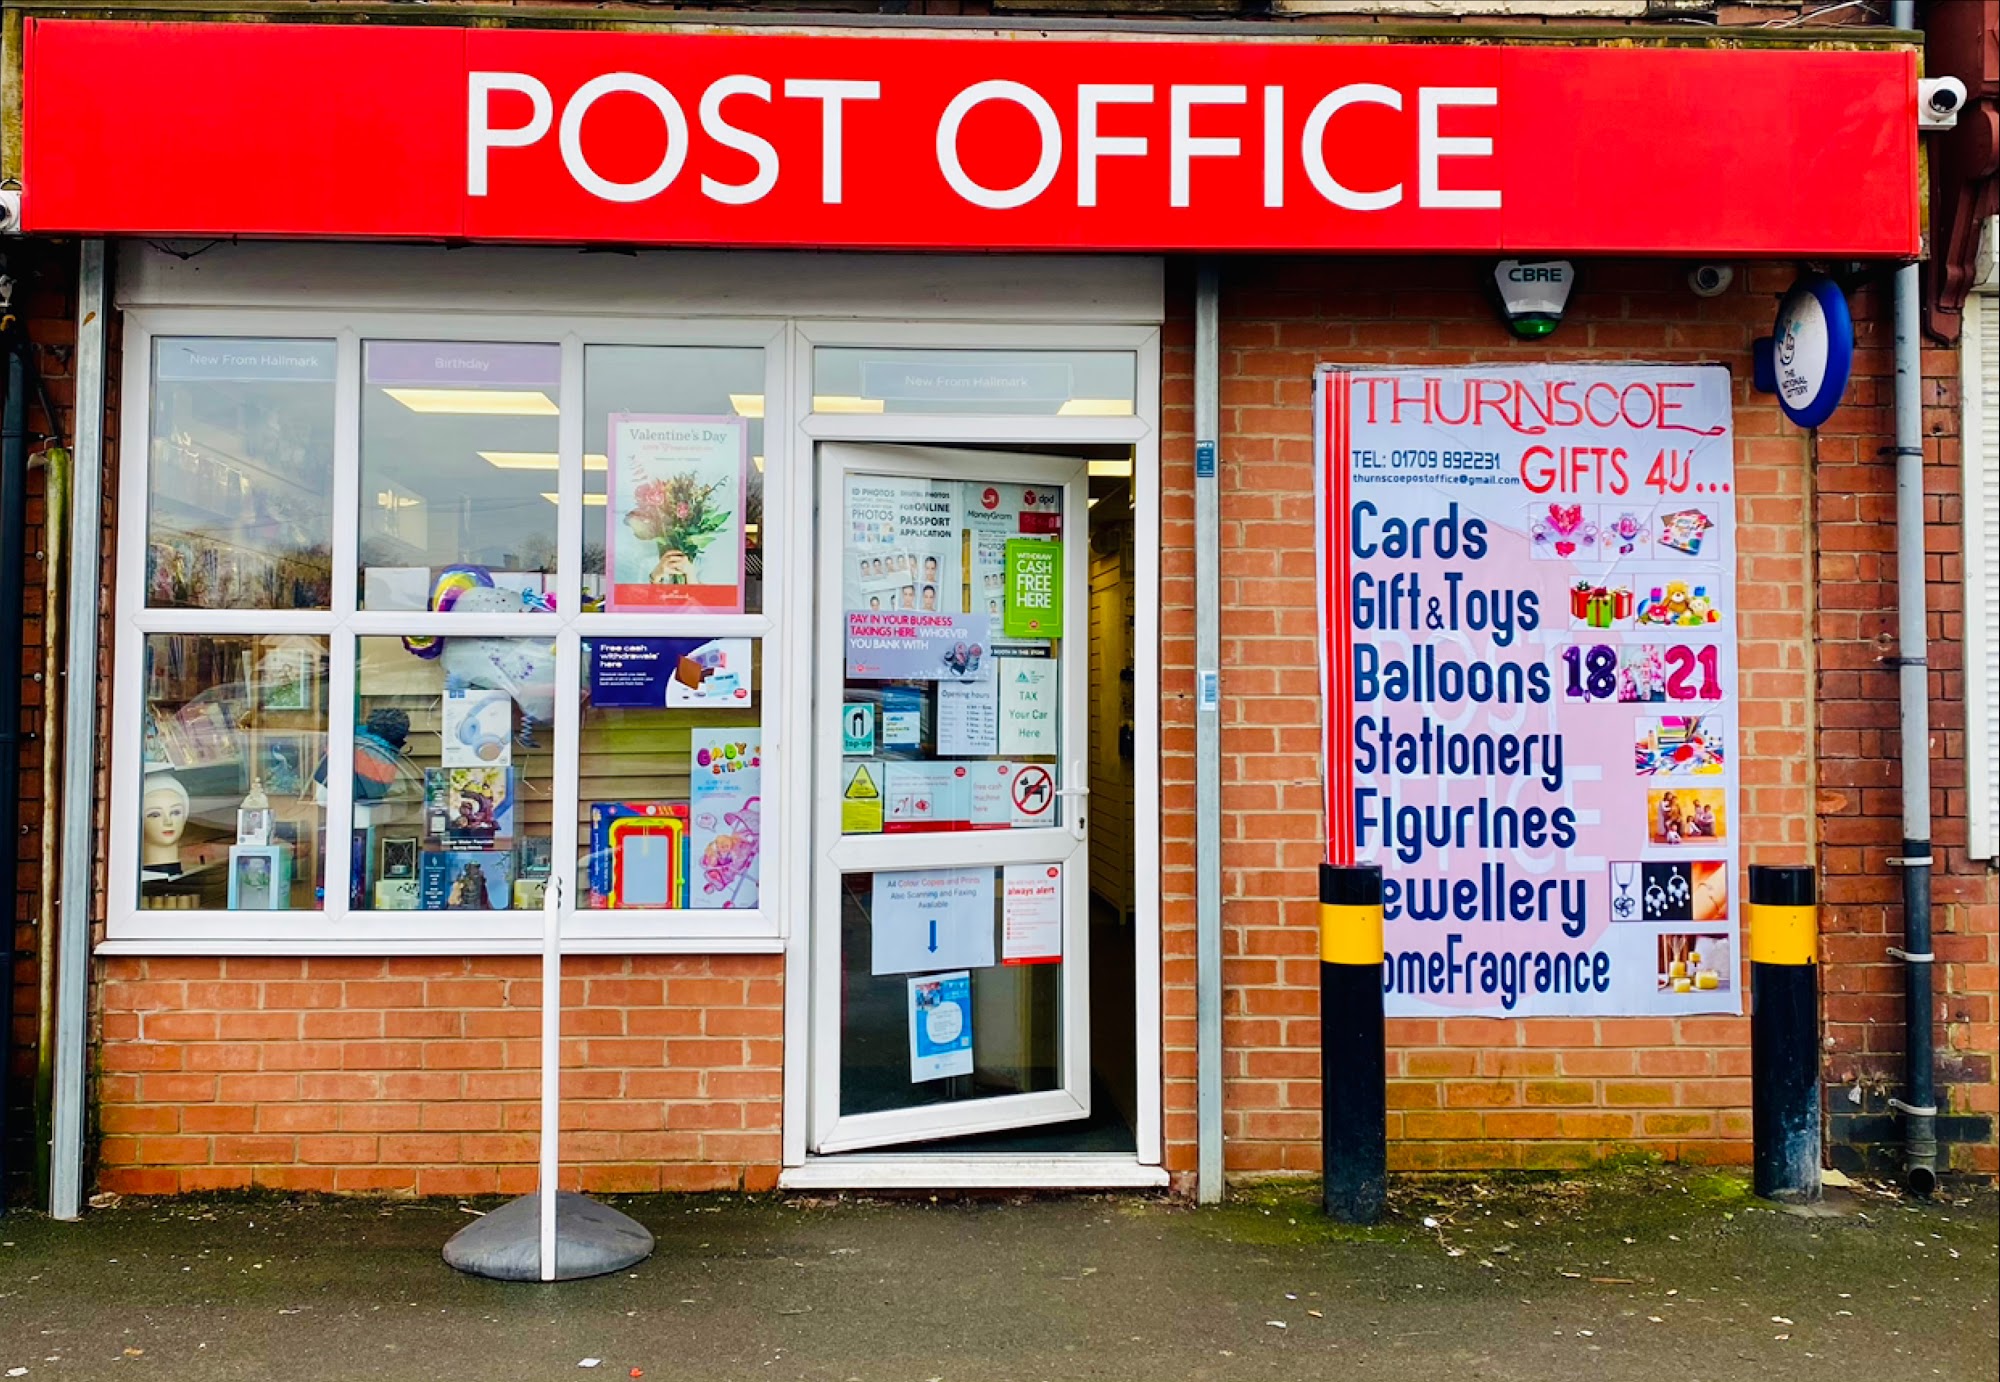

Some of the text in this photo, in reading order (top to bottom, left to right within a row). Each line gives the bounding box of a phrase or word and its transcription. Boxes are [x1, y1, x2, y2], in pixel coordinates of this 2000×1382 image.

[466, 71, 1502, 211] POST OFFICE
[1508, 267, 1562, 282] CBRE
[190, 353, 319, 369] New From Hallmark
[434, 357, 490, 371] Birthday
[905, 375, 1029, 388] New From Hallmark
[1351, 377, 1727, 437] THURNSCOE
[629, 427, 728, 444] Valentine's Day
[1352, 450, 1501, 470] TEL: 01709 892231
[1519, 444, 1629, 496] GIFTS
[1353, 473, 1520, 486] thurnscoepostoffice@gmail.com
[862, 488, 895, 497] PHOTOS
[1039, 494, 1055, 505] dpd
[914, 503, 950, 512] ONLINE
[852, 509, 895, 521] PHOTOS
[900, 515, 951, 526] PASSPORT
[968, 510, 1013, 521] MoneyGram
[900, 528, 951, 538] APPLICATION
[1352, 501, 1488, 560] Cards
[1016, 552, 1053, 561] WITHDRAW
[1016, 559, 1053, 574] CASH
[1016, 573, 1053, 592] FREE
[1016, 591, 1053, 609] HERE
[851, 614, 953, 627] PAY IN YOUR BUSINESS
[851, 625, 892, 636] TAKINGS
[919, 628, 968, 638] WHOEVER
[600, 644, 648, 652] Free cash
[851, 638, 929, 650] YOU BANK WITH
[600, 660, 623, 668] here
[1353, 643, 1551, 704] Balloons
[941, 689, 990, 700] Opening hours
[1019, 691, 1038, 701] TAX
[1009, 709, 1048, 720] Your Car
[1018, 728, 1041, 738] Here
[845, 740, 872, 749] top-up
[1354, 715, 1563, 792] Stationery
[712, 756, 760, 775] STROLLE
[1354, 787, 1576, 863] Figurines
[898, 880, 919, 888] Colour
[921, 878, 945, 887] Copies
[946, 877, 960, 885] and
[961, 876, 981, 884] Prints
[906, 891, 938, 900] Scanning
[954, 888, 977, 898] Faxing
[1008, 886, 1055, 897] always alert
[918, 900, 949, 908] Available
[1383, 863, 1586, 938] ewellery
[1384, 934, 1610, 1010] omeFragrance
